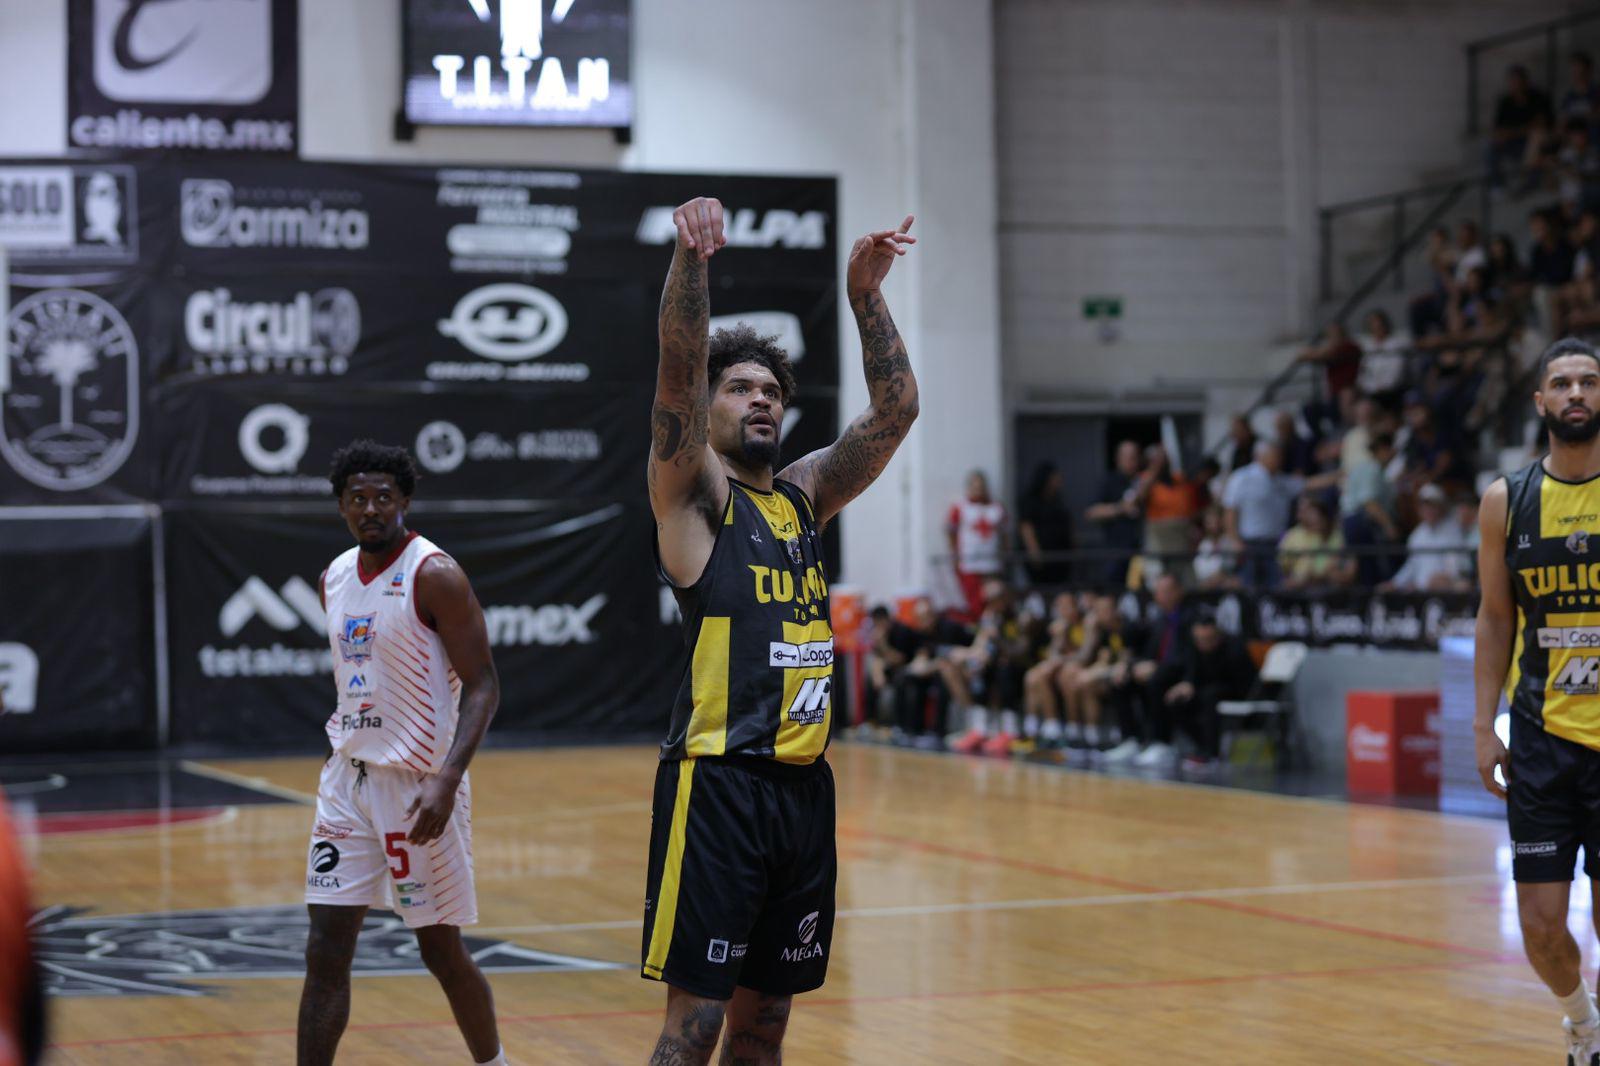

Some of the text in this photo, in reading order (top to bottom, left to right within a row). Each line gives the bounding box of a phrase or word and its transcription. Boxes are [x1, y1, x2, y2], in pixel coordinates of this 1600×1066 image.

[432, 55, 610, 101] TITAN
[71, 109, 294, 149] caliente.mx
[384, 831, 410, 880] 5
[781, 942, 823, 962] MEGA
